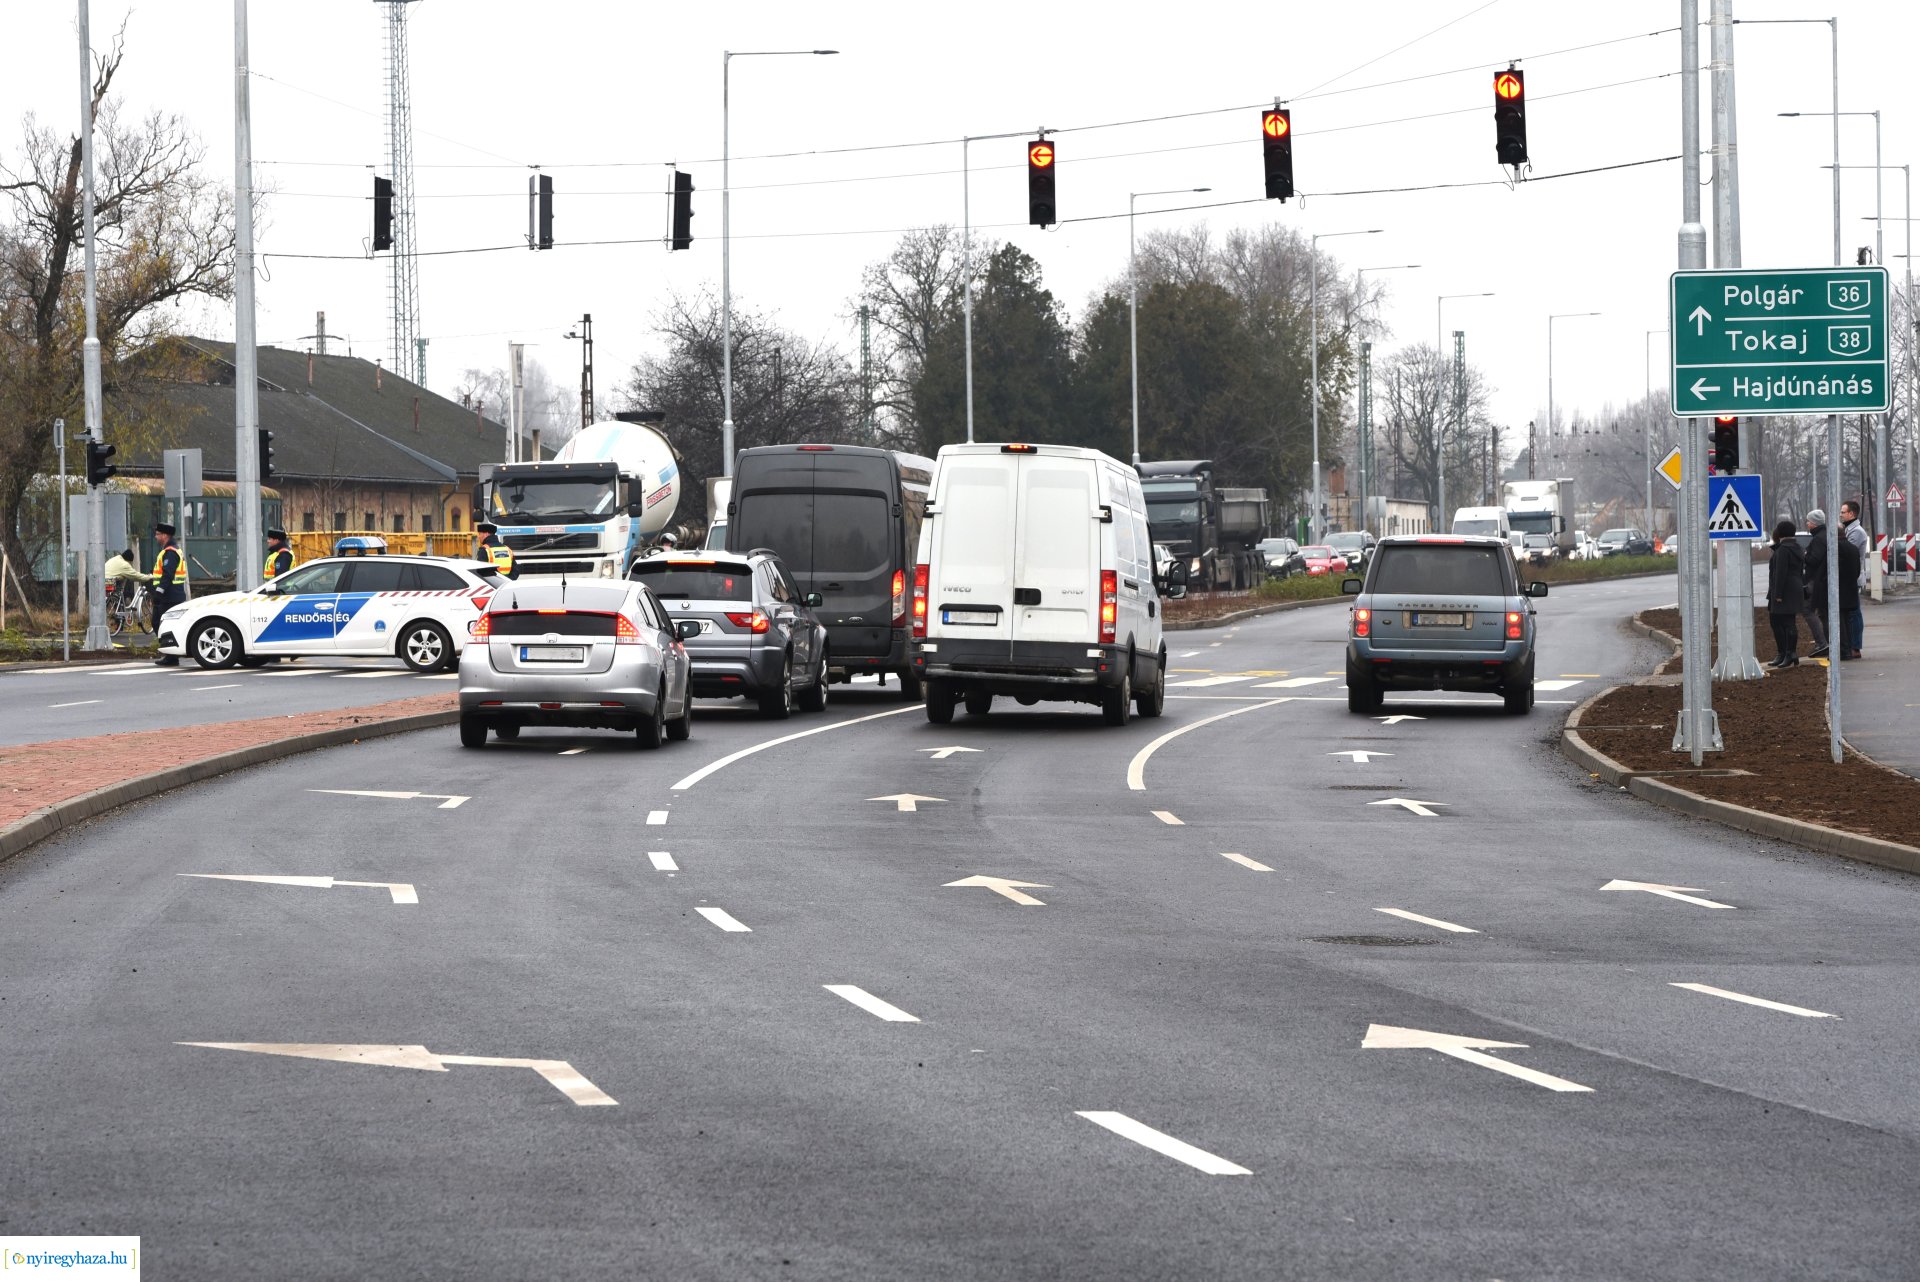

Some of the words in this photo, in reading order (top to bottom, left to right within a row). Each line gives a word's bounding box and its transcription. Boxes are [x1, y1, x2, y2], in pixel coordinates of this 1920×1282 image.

[1724, 284, 1803, 310] Polgár
[1838, 286, 1860, 303] 36
[1725, 329, 1807, 354] Tokaj
[1839, 332, 1860, 348] 38
[1733, 374, 1873, 402] Hajdúnánás
[285, 611, 350, 623] RENDŐRSÉG
